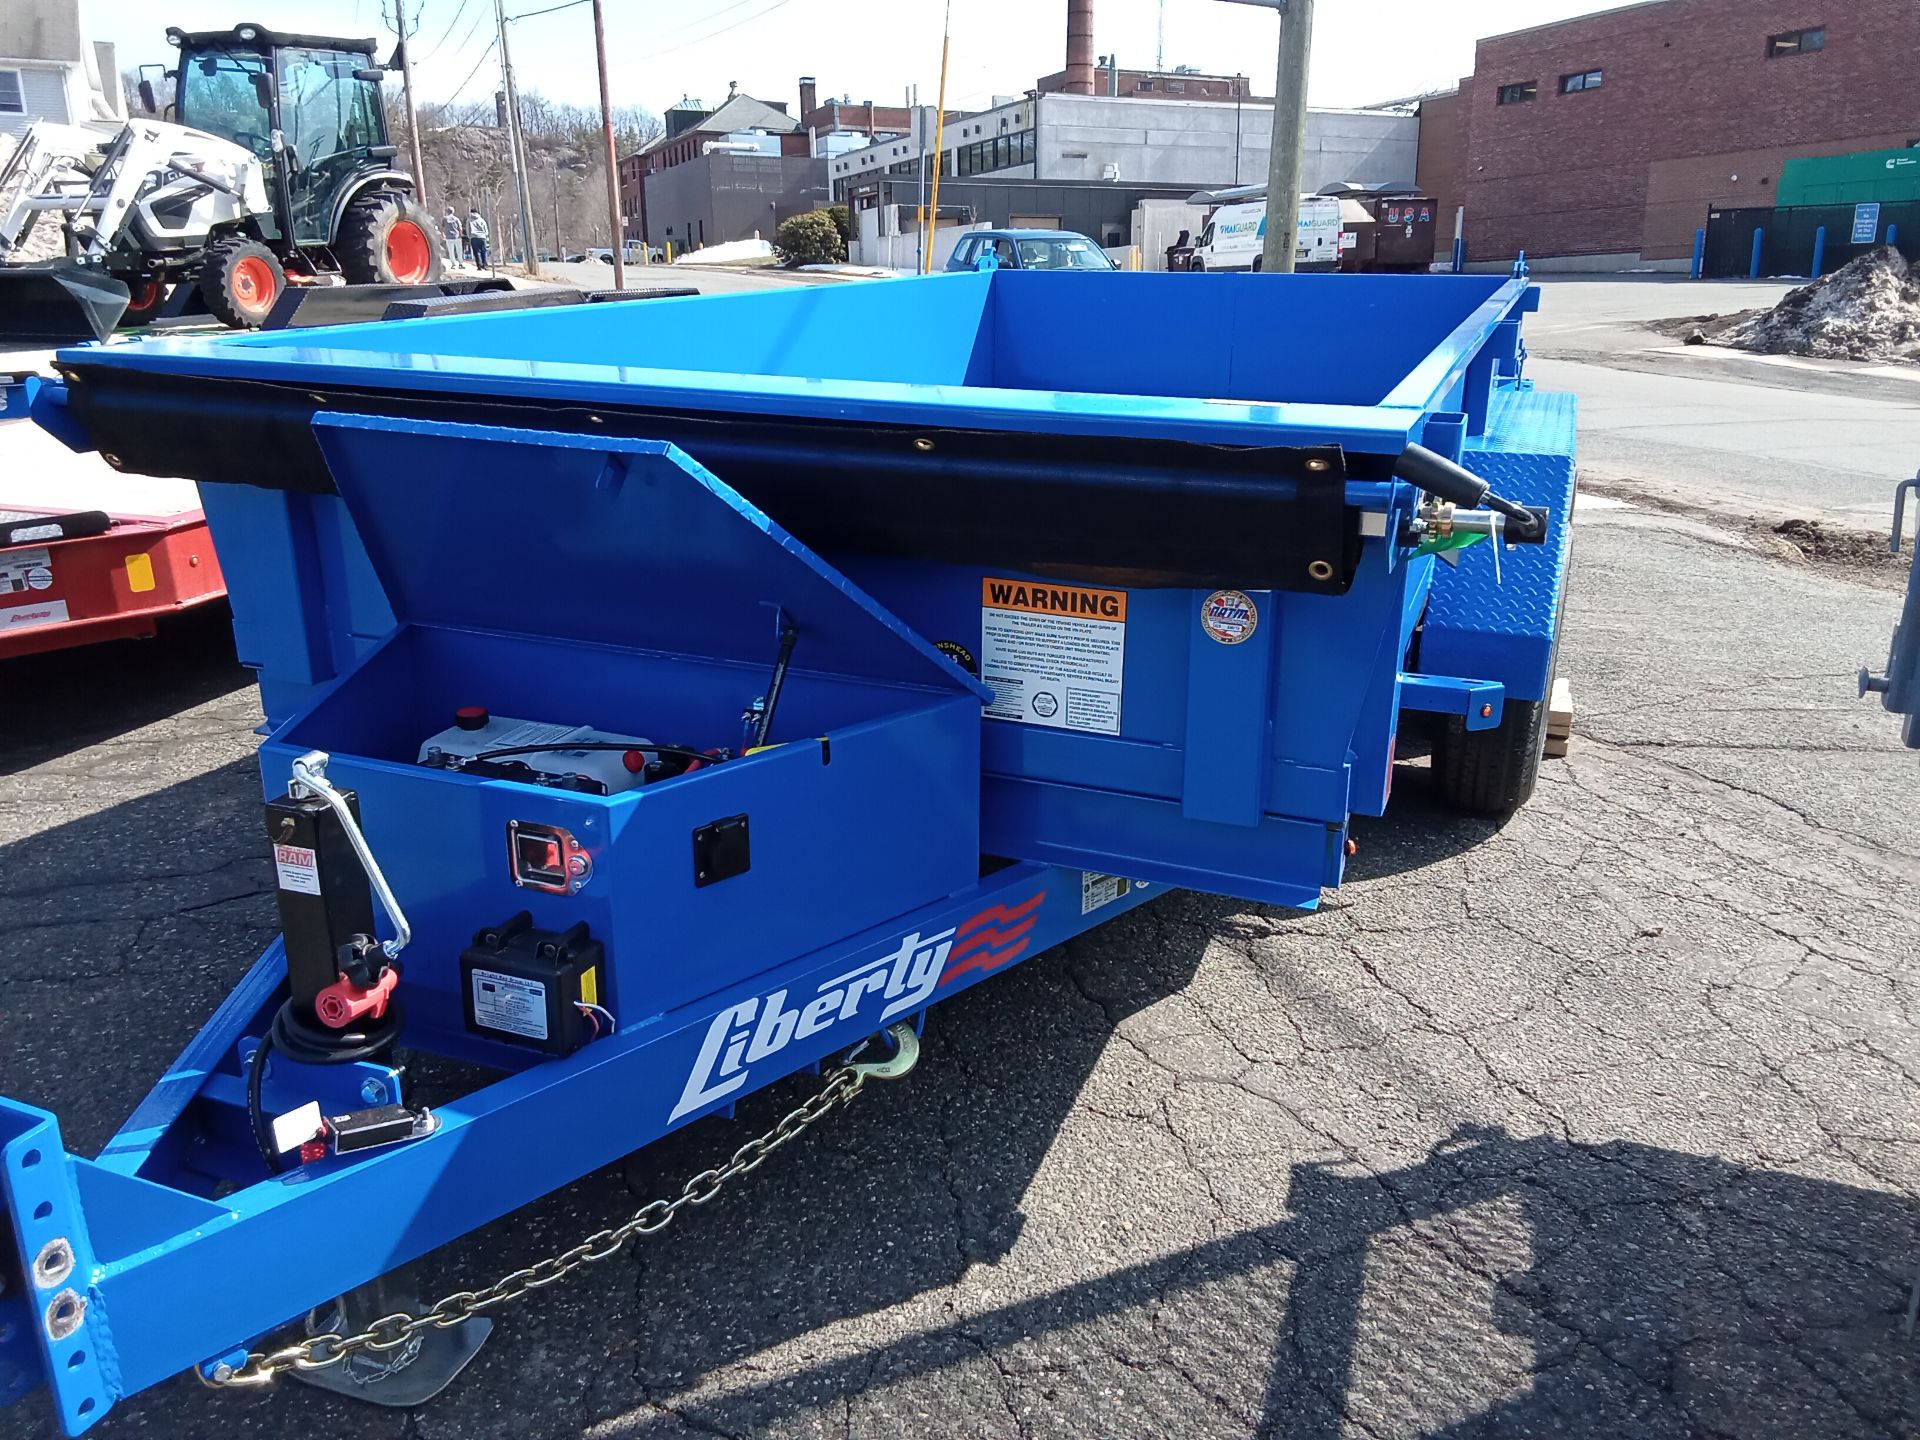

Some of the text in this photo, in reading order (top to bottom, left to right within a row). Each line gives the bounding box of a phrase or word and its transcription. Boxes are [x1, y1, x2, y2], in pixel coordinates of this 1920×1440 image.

[990, 583, 1120, 617] WARNING
[935, 642, 971, 662] NSHEAD
[279, 851, 313, 866] RAM
[667, 926, 956, 1126] Liberty
